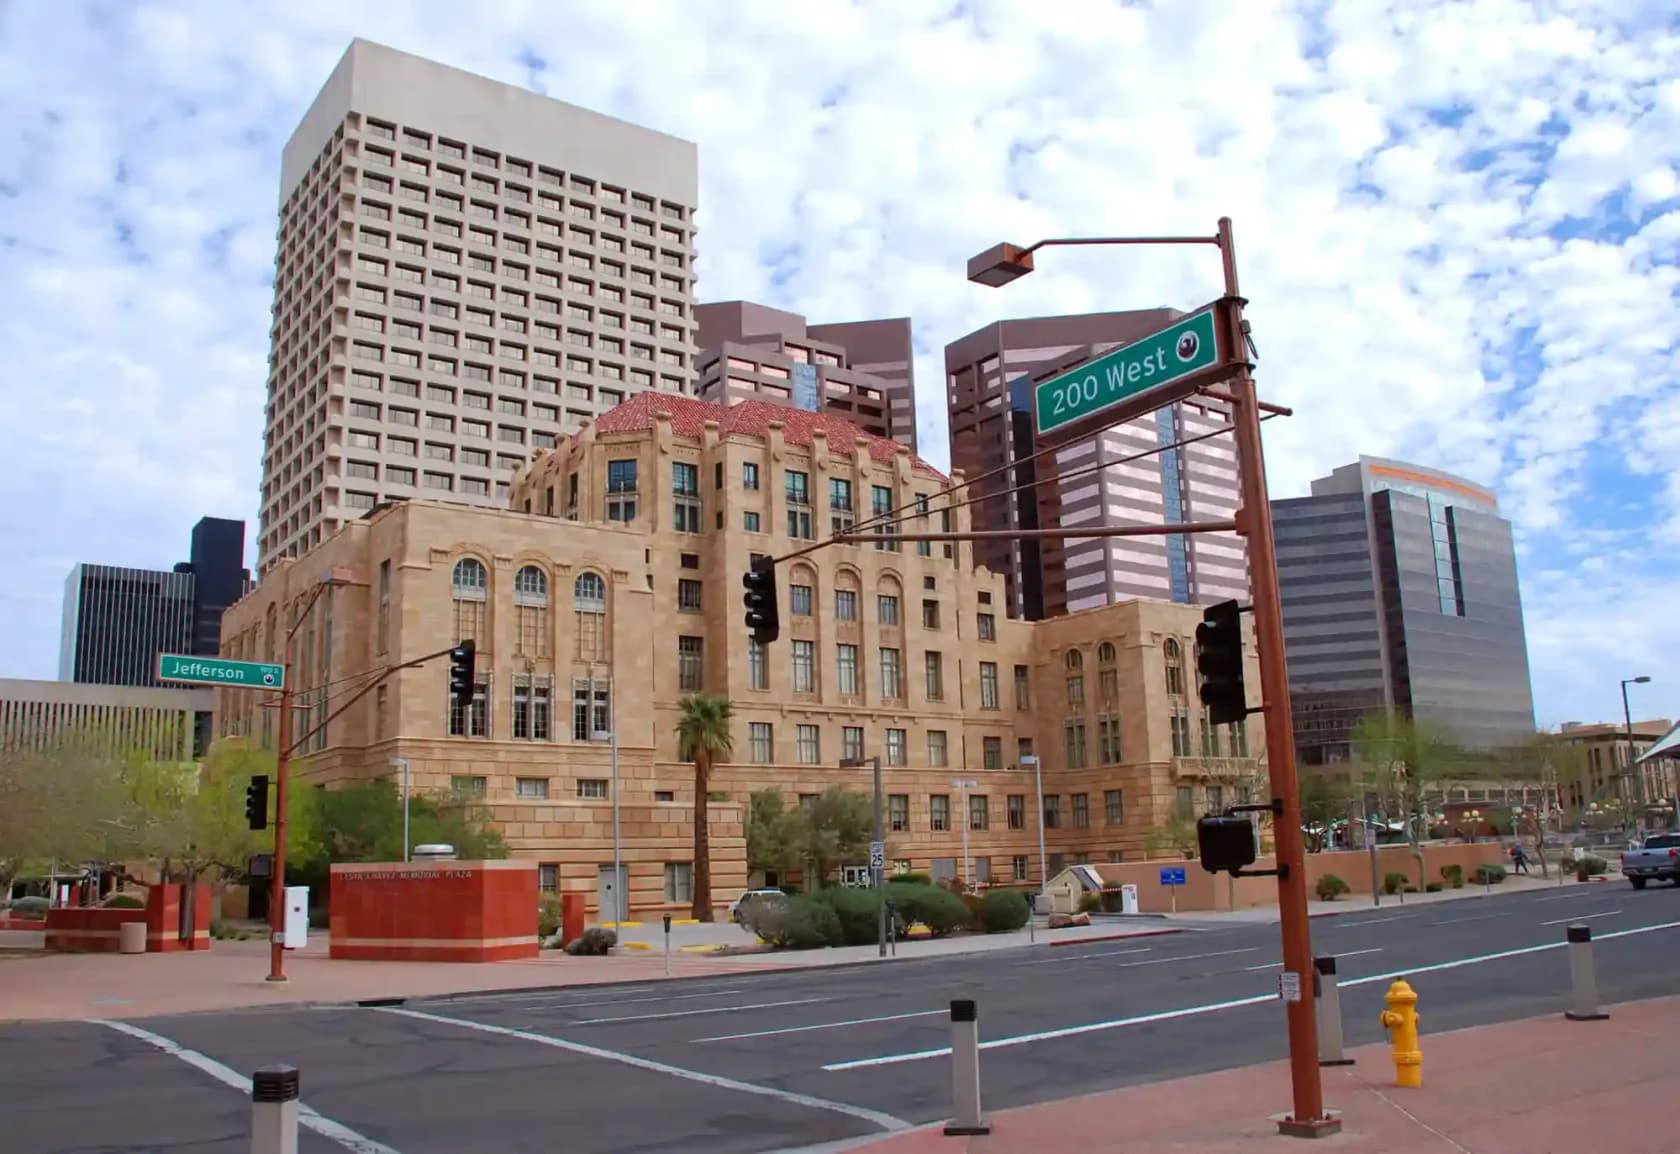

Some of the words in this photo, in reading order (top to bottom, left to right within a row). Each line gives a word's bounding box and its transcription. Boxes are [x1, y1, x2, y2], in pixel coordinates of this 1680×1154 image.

[1052, 375, 1098, 415] 200
[1106, 346, 1167, 392] West
[171, 661, 245, 680] Jefferson
[872, 854, 884, 867] 25
